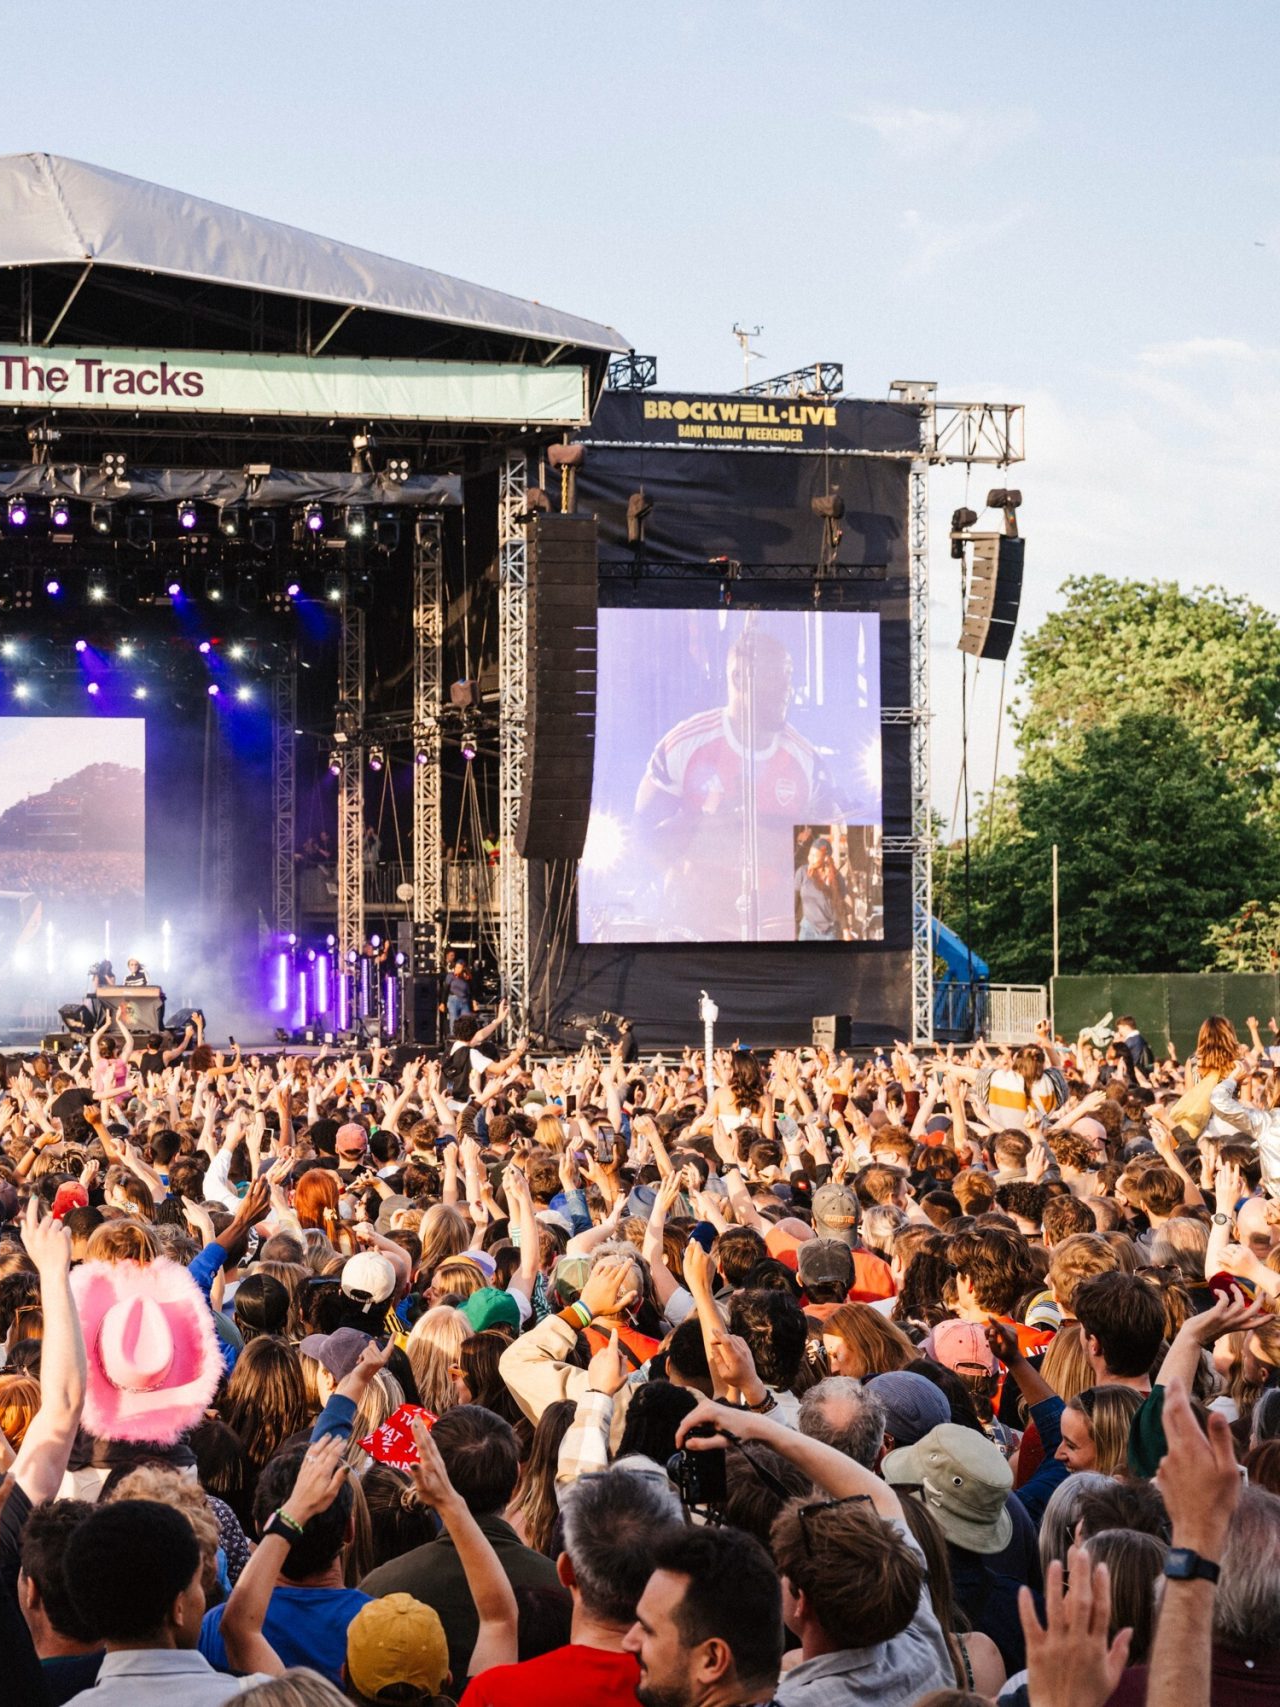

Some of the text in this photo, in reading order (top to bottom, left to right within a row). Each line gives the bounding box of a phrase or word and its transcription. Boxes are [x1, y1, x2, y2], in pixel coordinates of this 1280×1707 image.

[75, 358, 205, 397] Tracks
[677, 423, 804, 442] BANK HOLIDAY WEEKENDER
